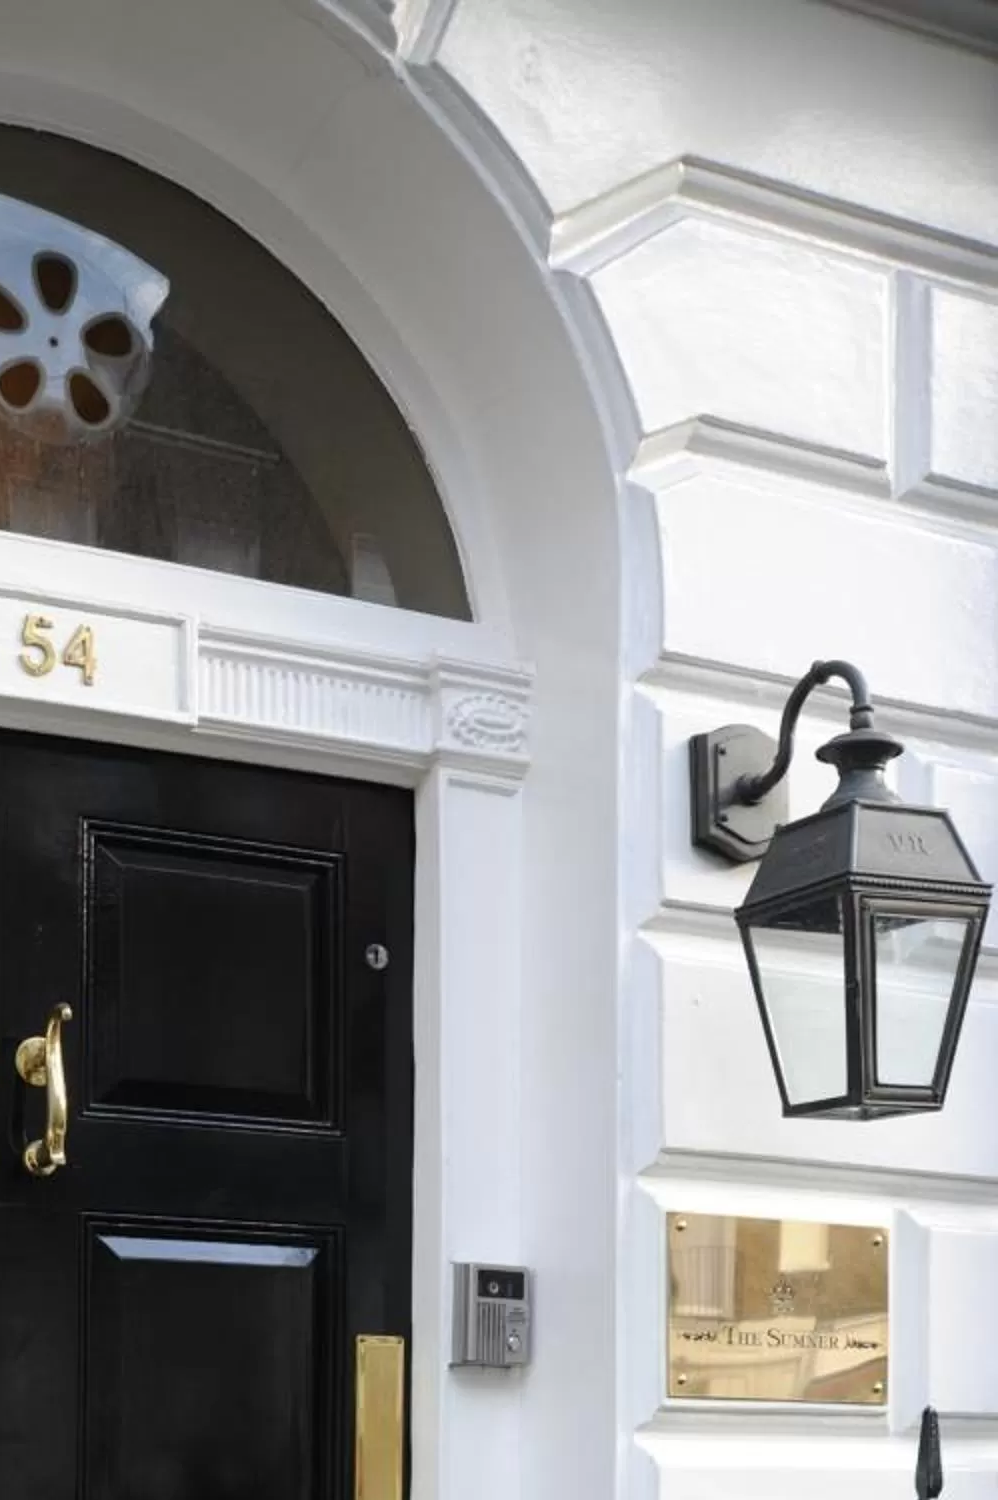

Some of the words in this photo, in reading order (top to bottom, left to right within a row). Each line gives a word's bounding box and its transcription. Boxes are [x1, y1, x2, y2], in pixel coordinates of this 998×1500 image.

[18, 613, 95, 687] 54
[723, 1325, 762, 1347] THE
[767, 1328, 840, 1351] SUMNER
